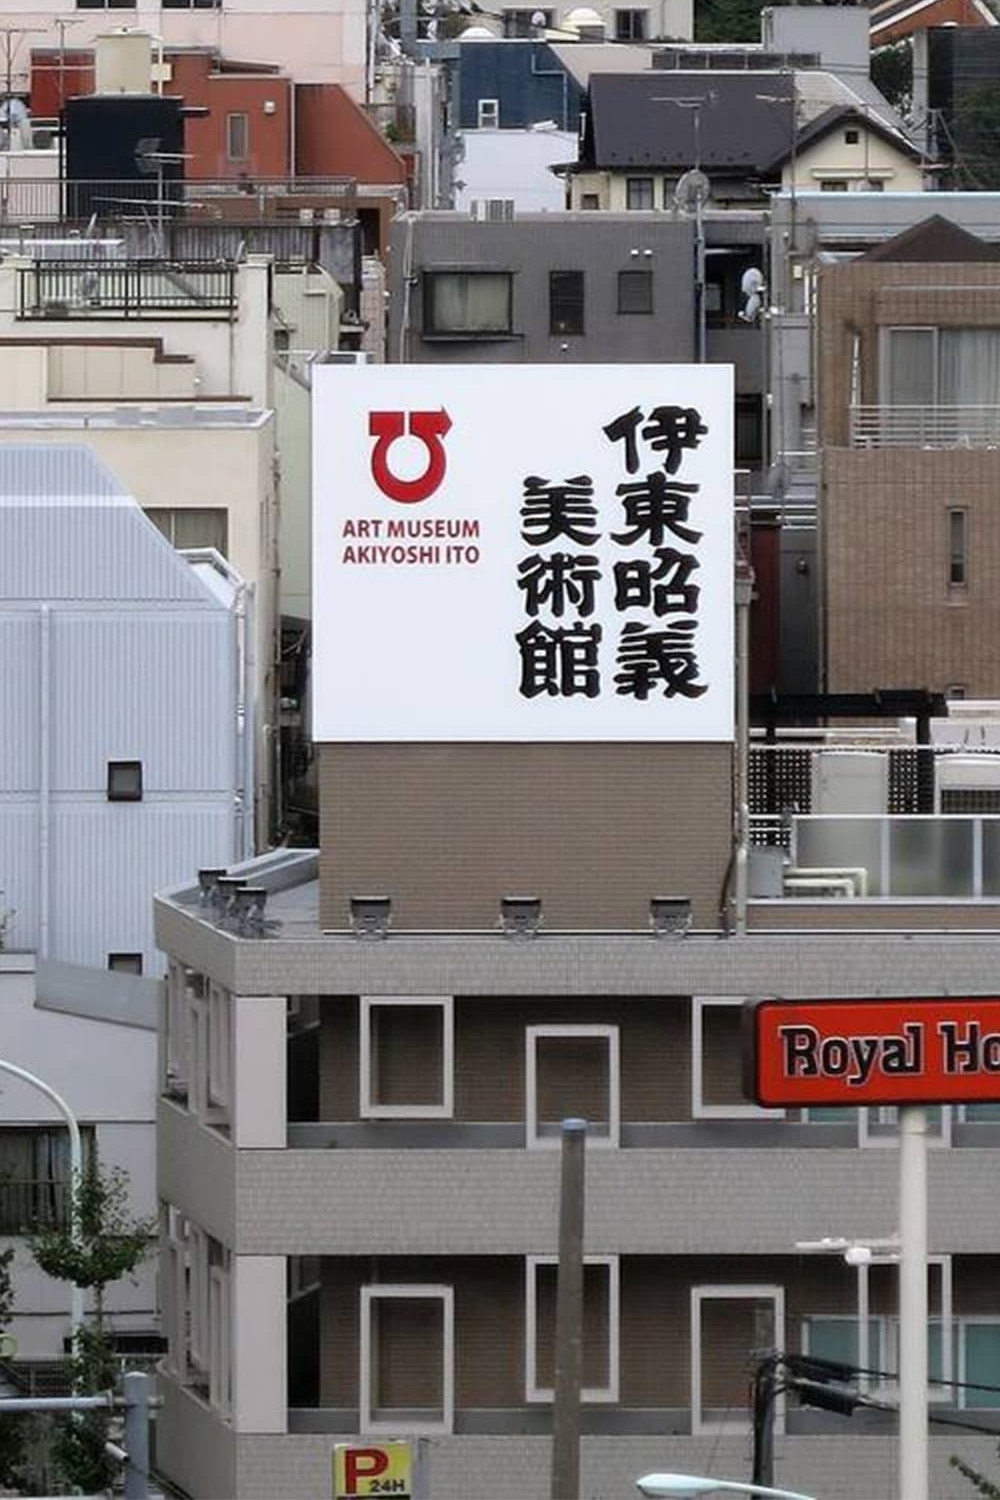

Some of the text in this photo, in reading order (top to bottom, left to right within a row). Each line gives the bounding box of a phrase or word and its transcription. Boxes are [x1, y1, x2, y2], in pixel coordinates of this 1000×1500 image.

[342, 519, 480, 538] ART MUSEUM
[342, 545, 480, 564] AKIYOSHI ITO
[602, 404, 708, 701] 伊東昭義
[515, 475, 602, 699] 美術館
[778, 1022, 924, 1087] Royal
[345, 1448, 388, 1494] P
[369, 1479, 405, 1493] 24H
